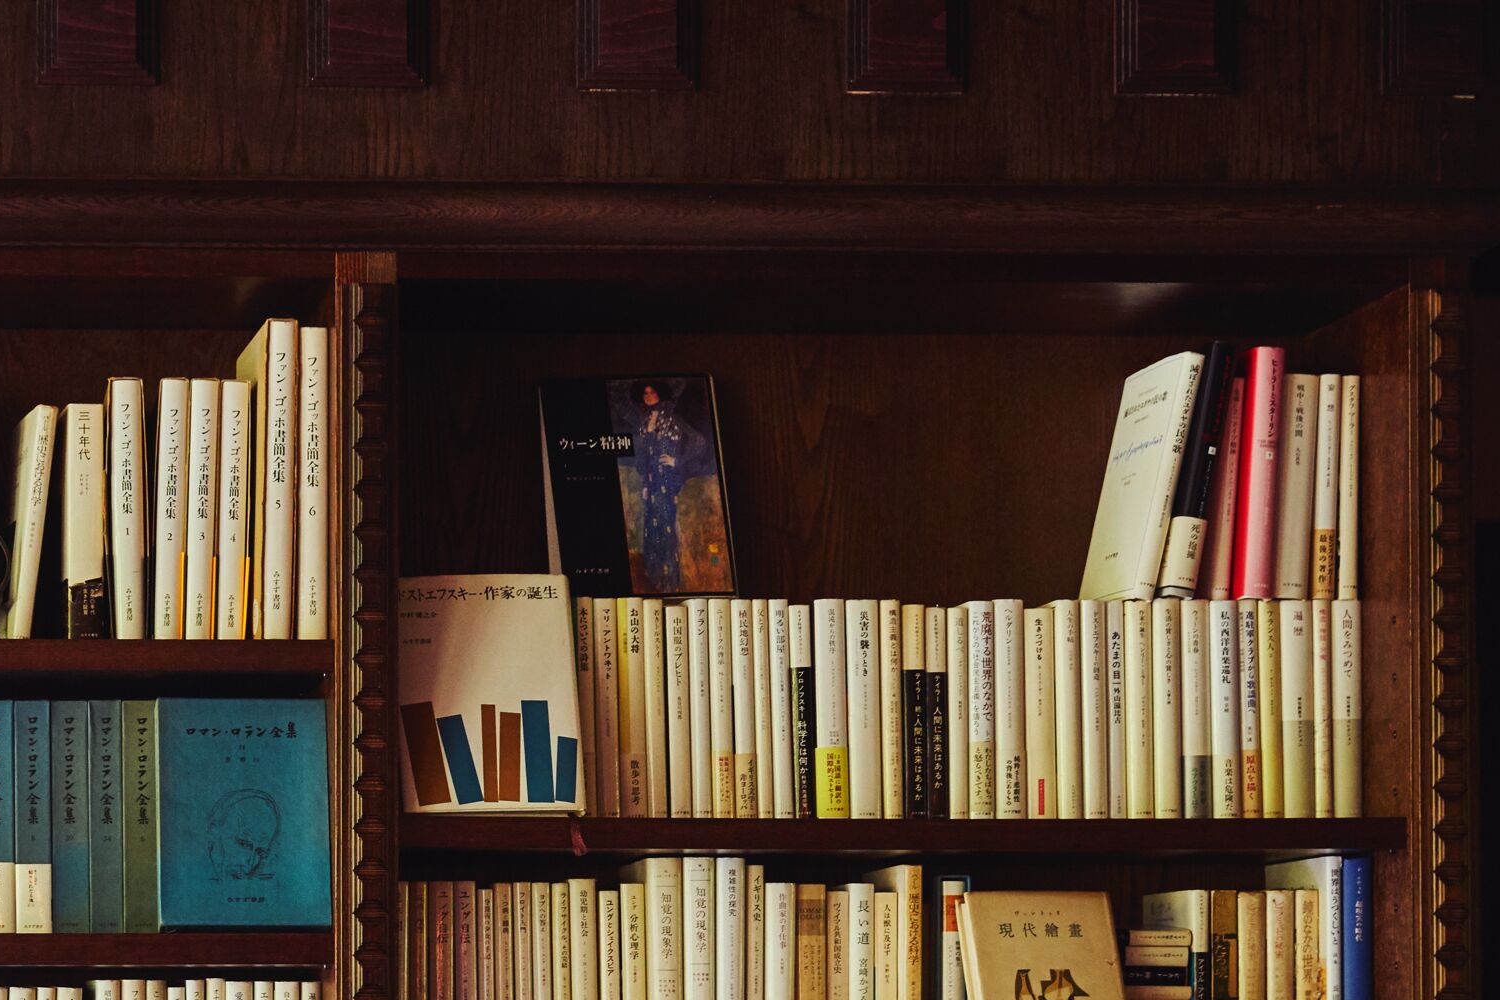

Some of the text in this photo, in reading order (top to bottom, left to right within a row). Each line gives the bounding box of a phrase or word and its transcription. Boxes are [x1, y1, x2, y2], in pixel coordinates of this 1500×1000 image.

[559, 436, 631, 450] ウィーン精神
[25, 717, 41, 826] ロマン・ロラン全集
[61, 717, 77, 826] ロマン・ロラン全集
[99, 717, 116, 826] ロマン・ロラン全集
[135, 717, 151, 826] ロマン・ロラン全集
[184, 721, 298, 739] ロマン・ロラン全集
[857, 900, 870, 945] 長い道
